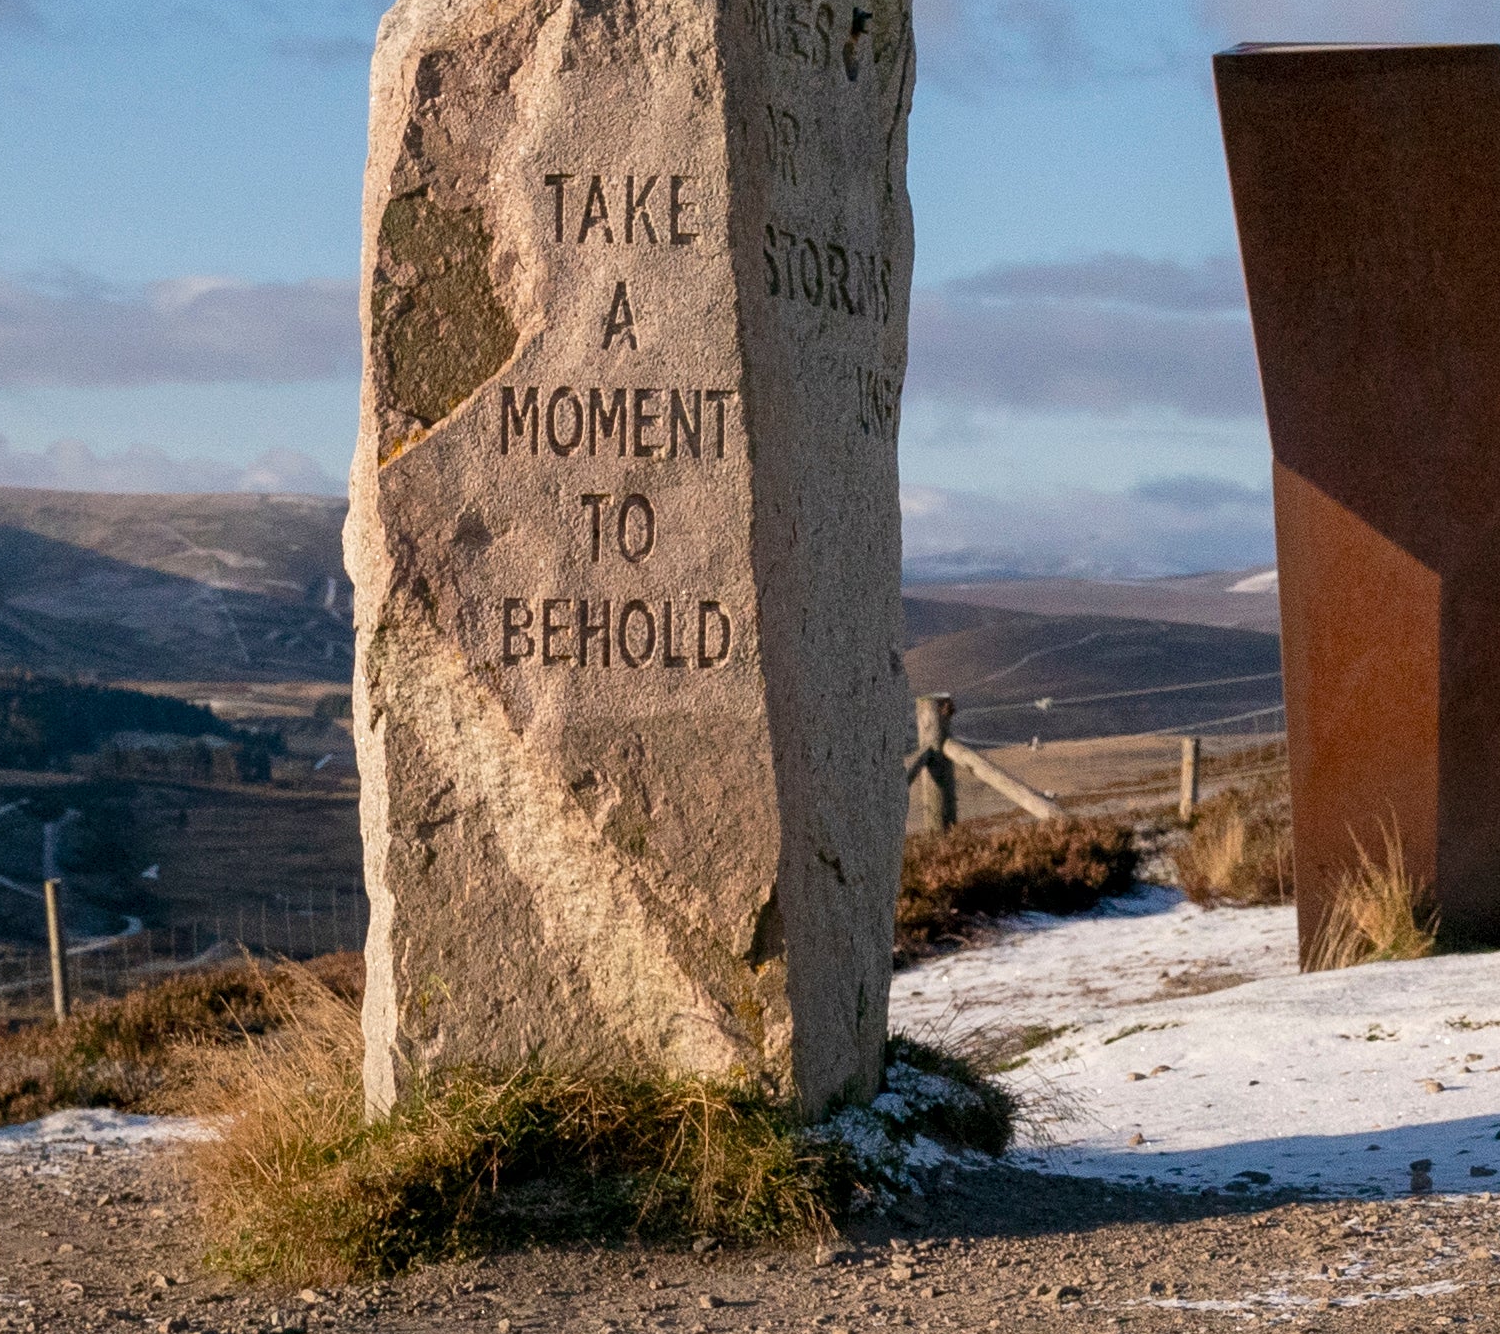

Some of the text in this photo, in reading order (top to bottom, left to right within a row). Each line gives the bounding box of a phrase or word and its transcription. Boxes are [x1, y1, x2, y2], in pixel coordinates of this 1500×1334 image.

[544, 173, 701, 246] TAKE
[763, 223, 892, 326] STORMS
[601, 281, 638, 351] A
[500, 385, 739, 459] MOMENT
[581, 493, 657, 563] TO
[503, 597, 733, 669] BEHOLD
